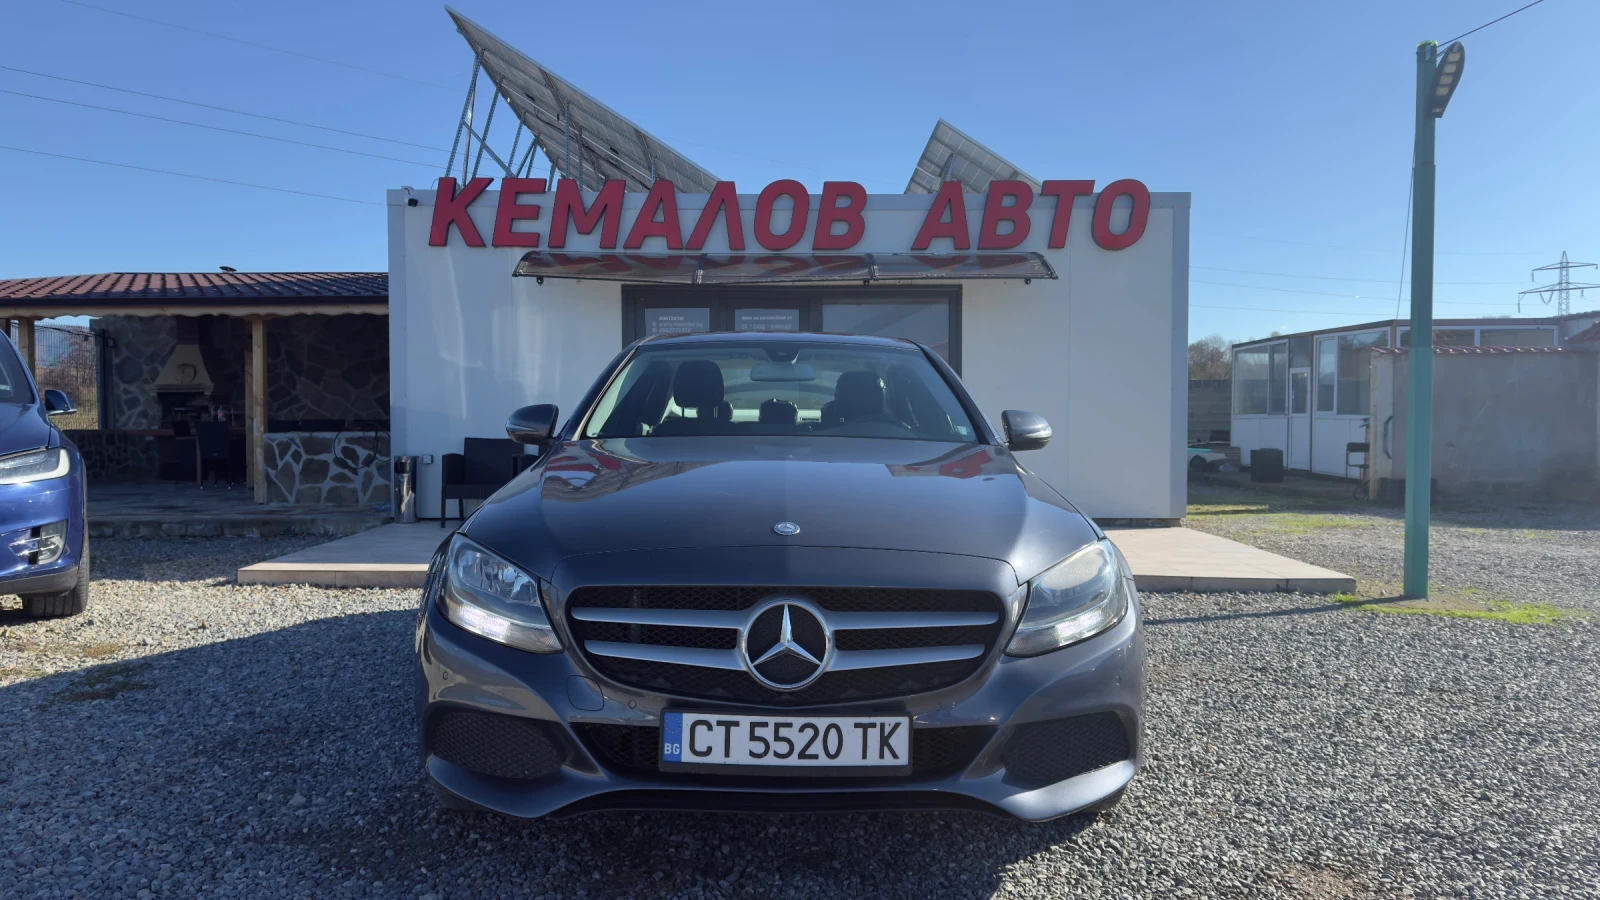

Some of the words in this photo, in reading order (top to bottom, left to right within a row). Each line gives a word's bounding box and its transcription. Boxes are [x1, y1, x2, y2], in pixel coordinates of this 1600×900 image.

[428, 176, 868, 251] КЕМАЛОВ
[910, 178, 1151, 251] АВТО
[664, 743, 680, 755] BG
[689, 719, 740, 758] CT
[748, 721, 844, 760] 5520
[853, 722, 902, 760] TK
